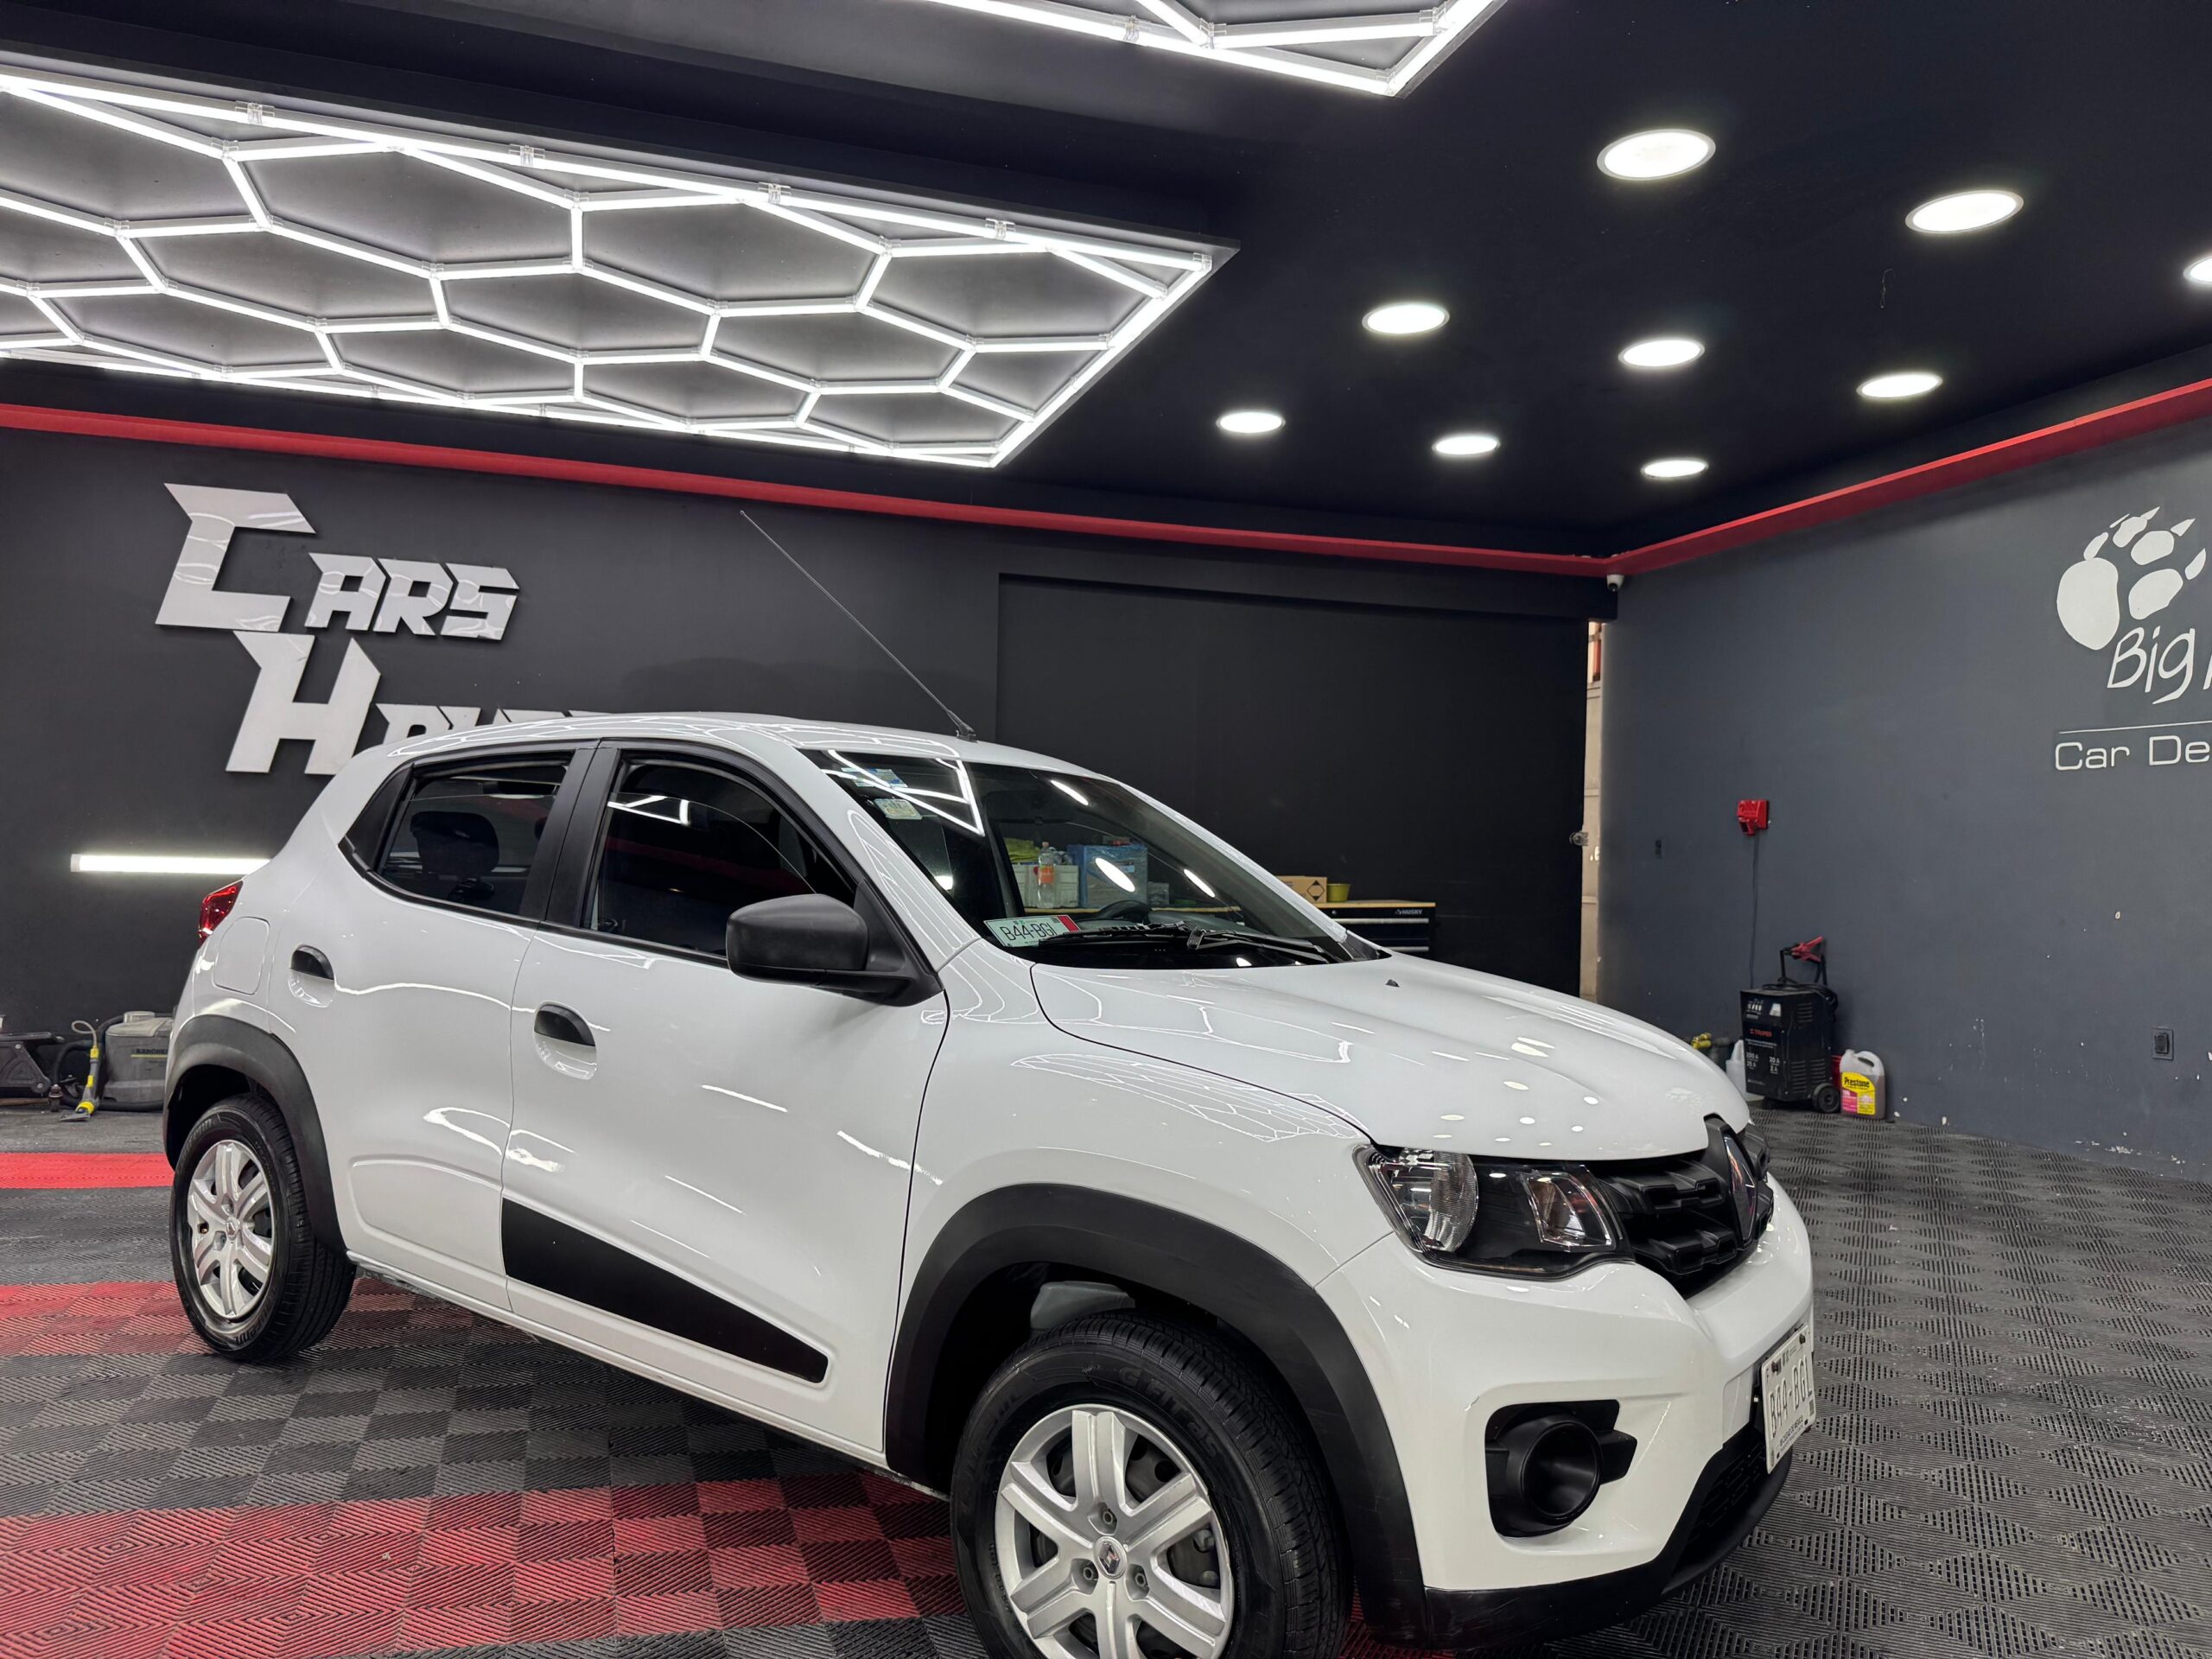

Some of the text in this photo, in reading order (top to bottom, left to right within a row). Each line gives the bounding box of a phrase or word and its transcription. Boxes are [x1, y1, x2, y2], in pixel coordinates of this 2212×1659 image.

[2107, 626, 2196, 705] Big
[2055, 741, 2130, 770] Car
[1844, 1077, 1870, 1089] Prestone
[1769, 1355, 1812, 1439] B44-BGL
